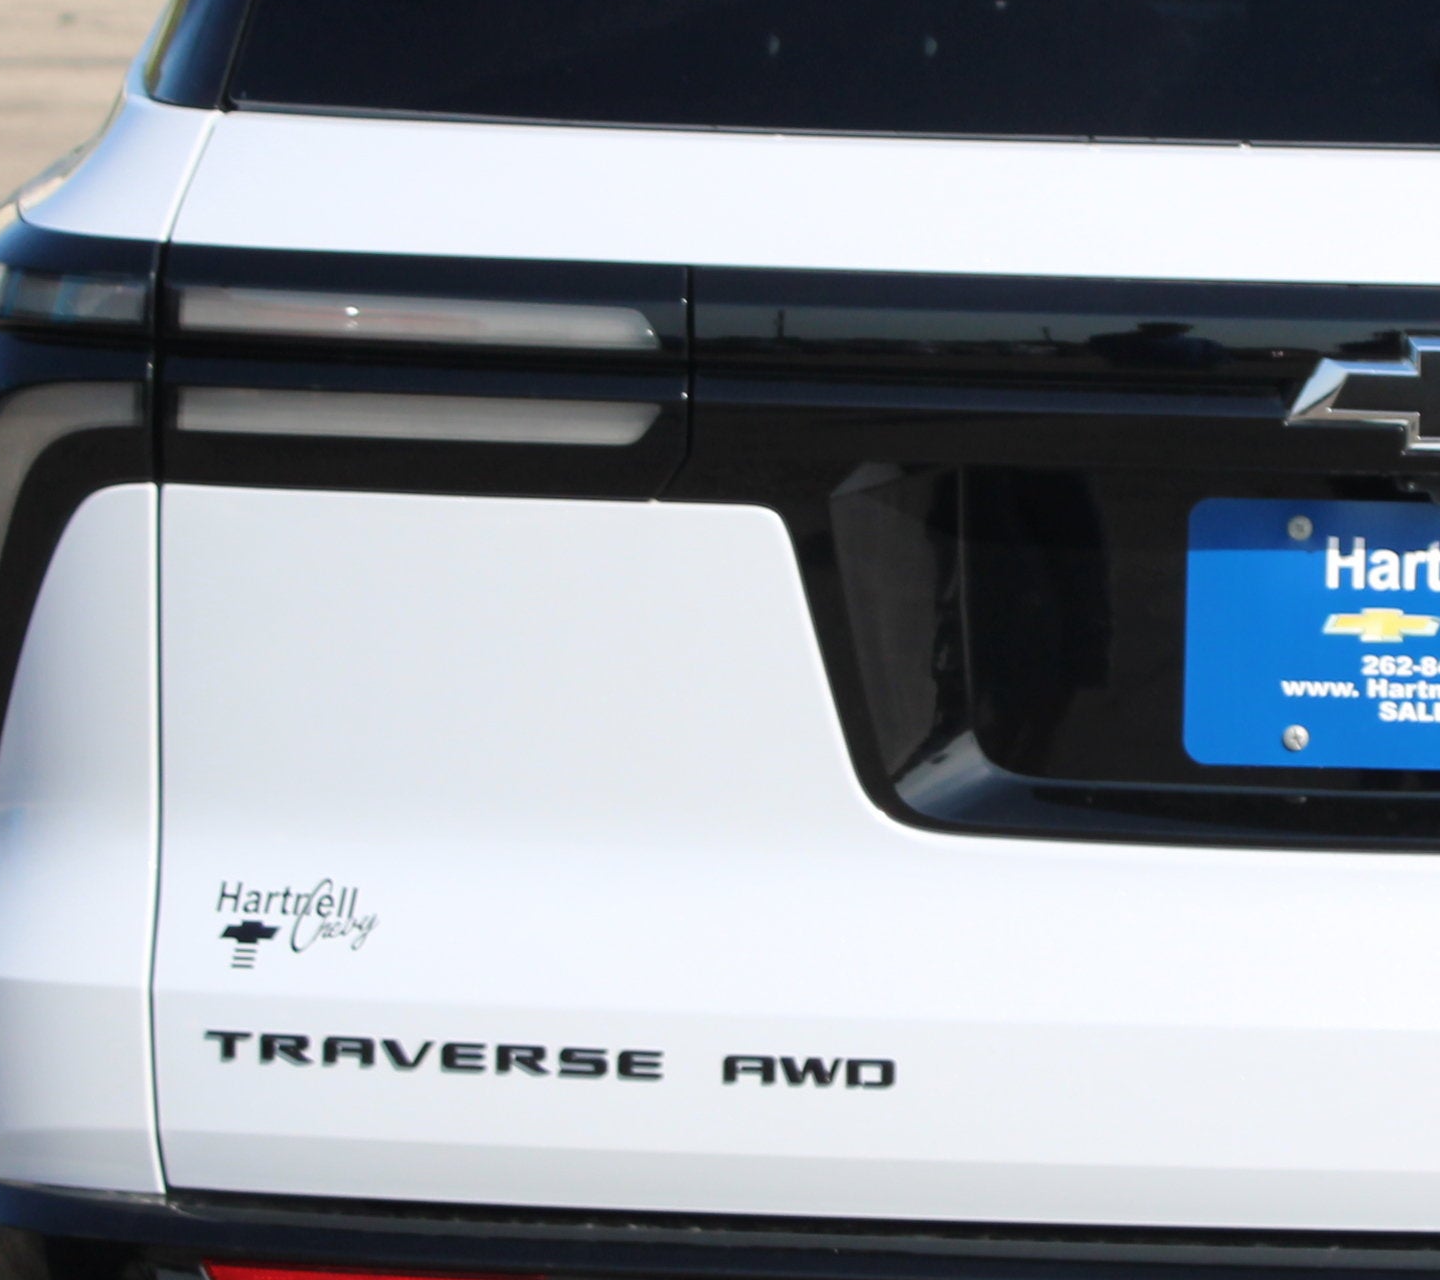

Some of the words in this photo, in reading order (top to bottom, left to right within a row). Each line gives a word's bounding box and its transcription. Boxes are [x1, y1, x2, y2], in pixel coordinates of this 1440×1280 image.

[216, 881, 357, 919] Hartnell
[291, 878, 380, 953] Chevy
[204, 1029, 664, 1081] TRAVERSE
[722, 1054, 895, 1089] AWD
